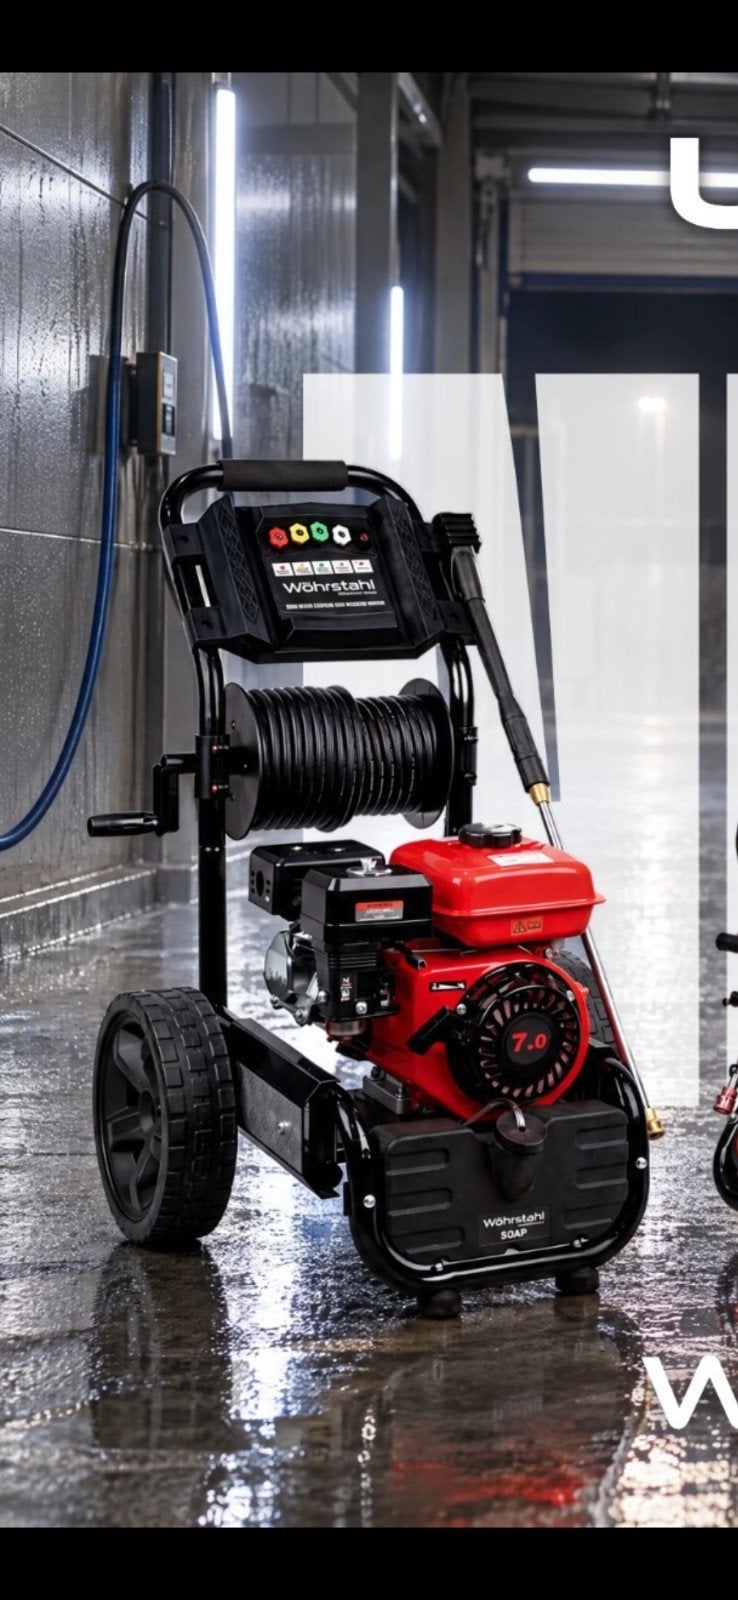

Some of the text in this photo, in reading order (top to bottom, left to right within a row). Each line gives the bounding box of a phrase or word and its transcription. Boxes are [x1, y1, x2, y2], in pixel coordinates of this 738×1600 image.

[283, 579, 376, 594] Wöhrstahl
[512, 1032, 548, 1053] 7.0
[483, 1211, 545, 1228] Wöhrstahl
[501, 1228, 527, 1240] SOAP
